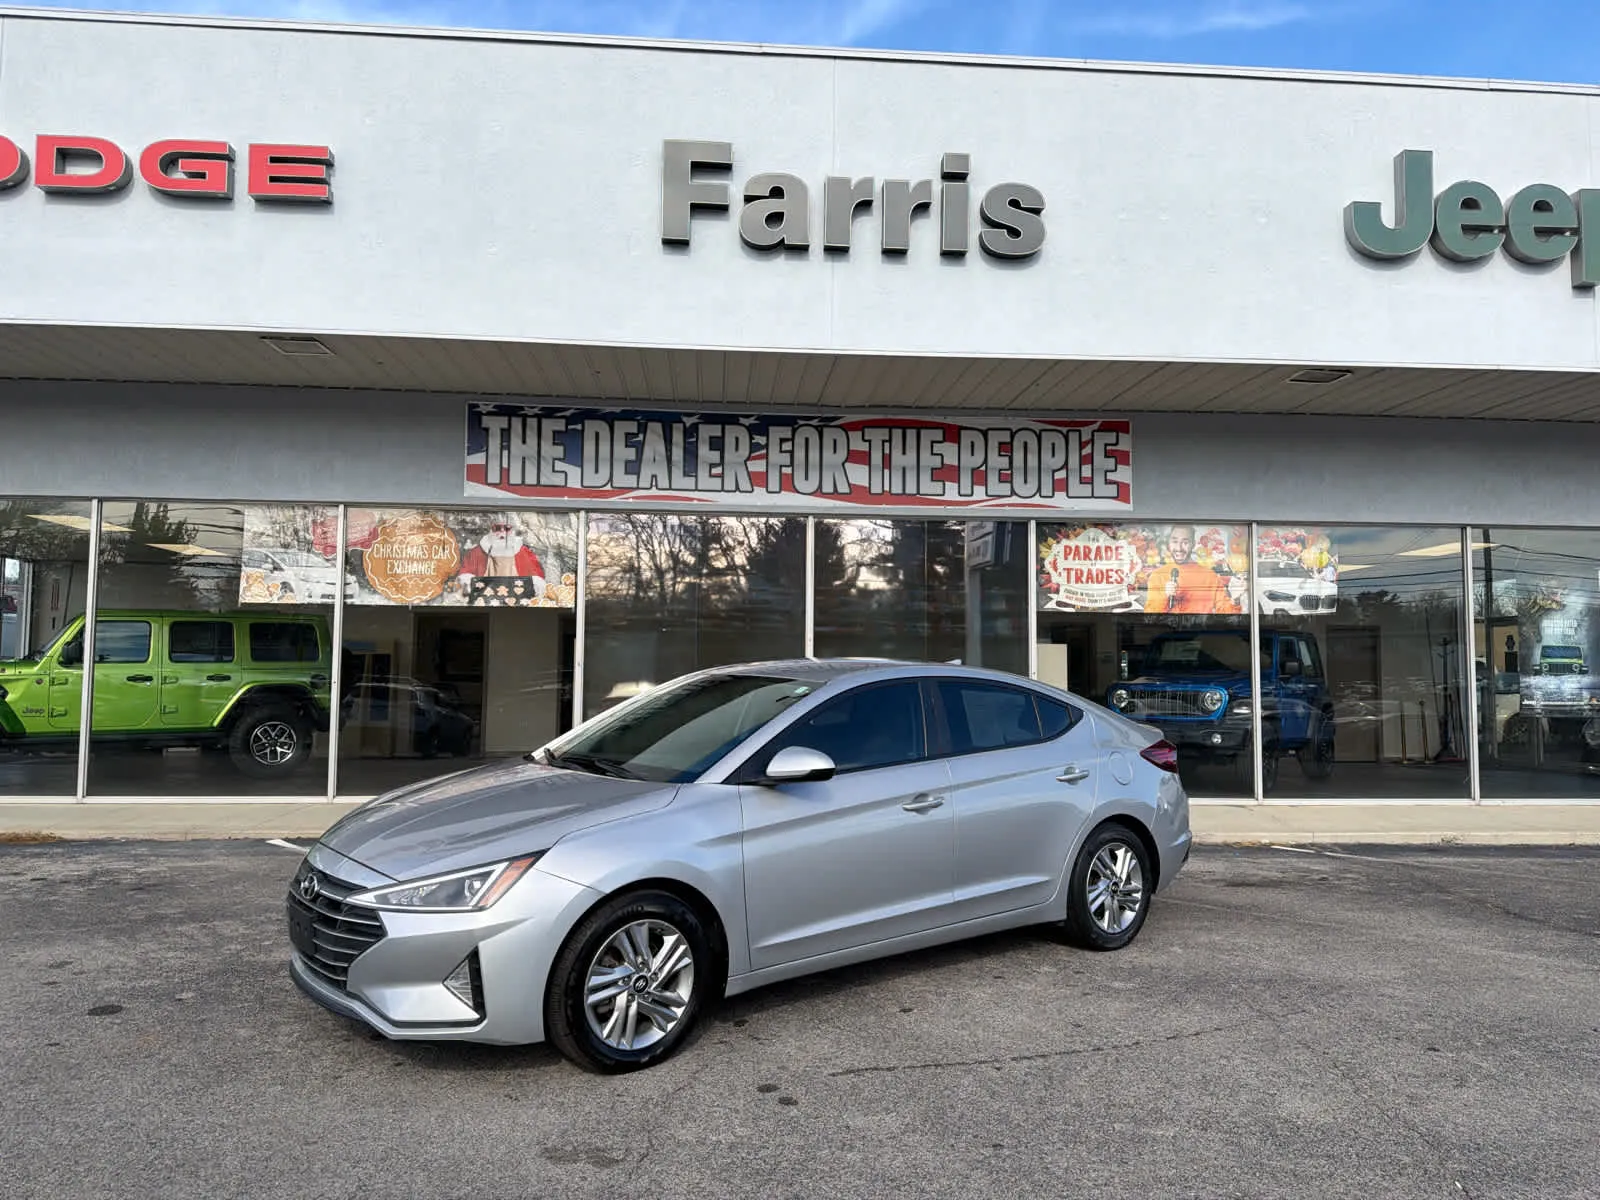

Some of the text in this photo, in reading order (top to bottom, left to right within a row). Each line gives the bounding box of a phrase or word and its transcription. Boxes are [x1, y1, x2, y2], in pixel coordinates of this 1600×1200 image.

[661, 139, 1047, 258] Farris
[481, 415, 1120, 499] THE DEALER FOR THE PEOPLE
[373, 543, 451, 560] CHRISTMAS CAR
[1064, 545, 1124, 560] PARADE
[387, 559, 437, 575] EXCHANGE
[1063, 567, 1124, 584] TRADES
